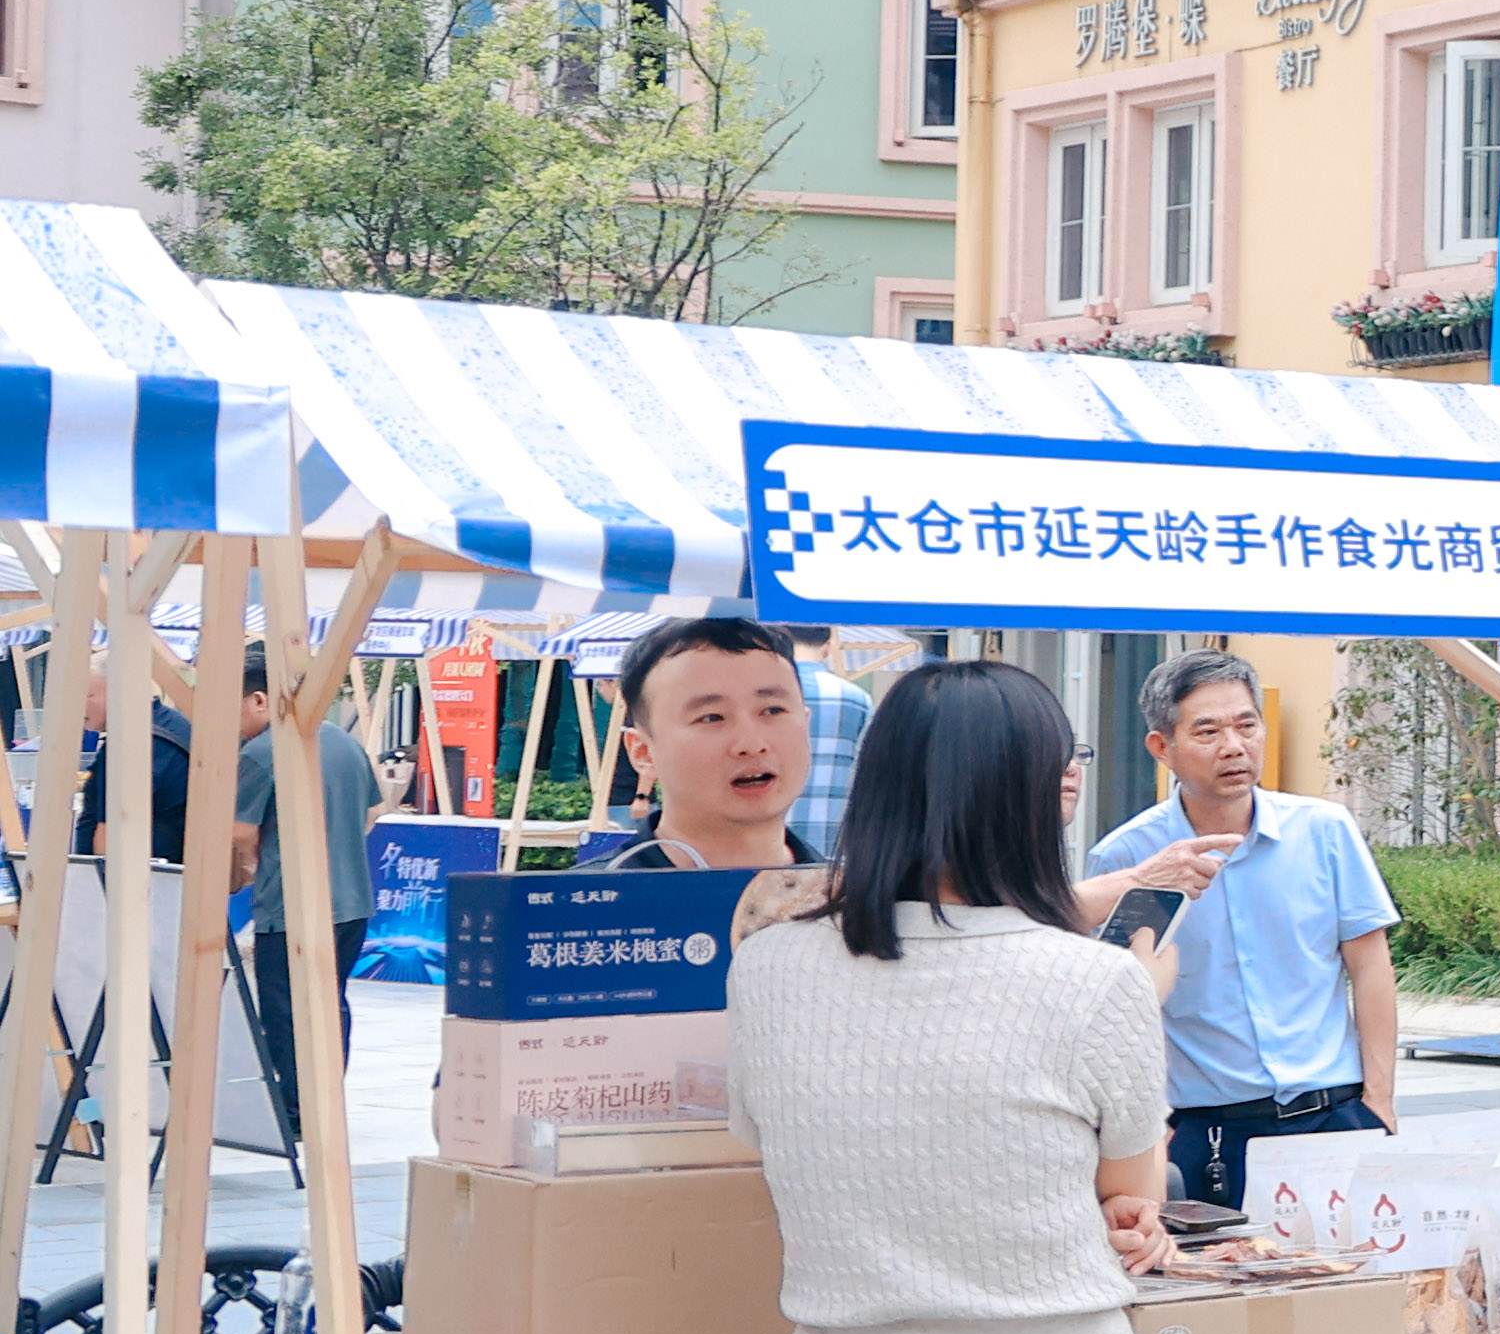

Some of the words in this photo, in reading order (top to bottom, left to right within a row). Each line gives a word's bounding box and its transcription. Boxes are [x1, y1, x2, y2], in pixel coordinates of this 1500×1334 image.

[1276, 44, 1320, 91] 餐厅
[525, 937, 682, 968] 葛根姜米槐蜜
